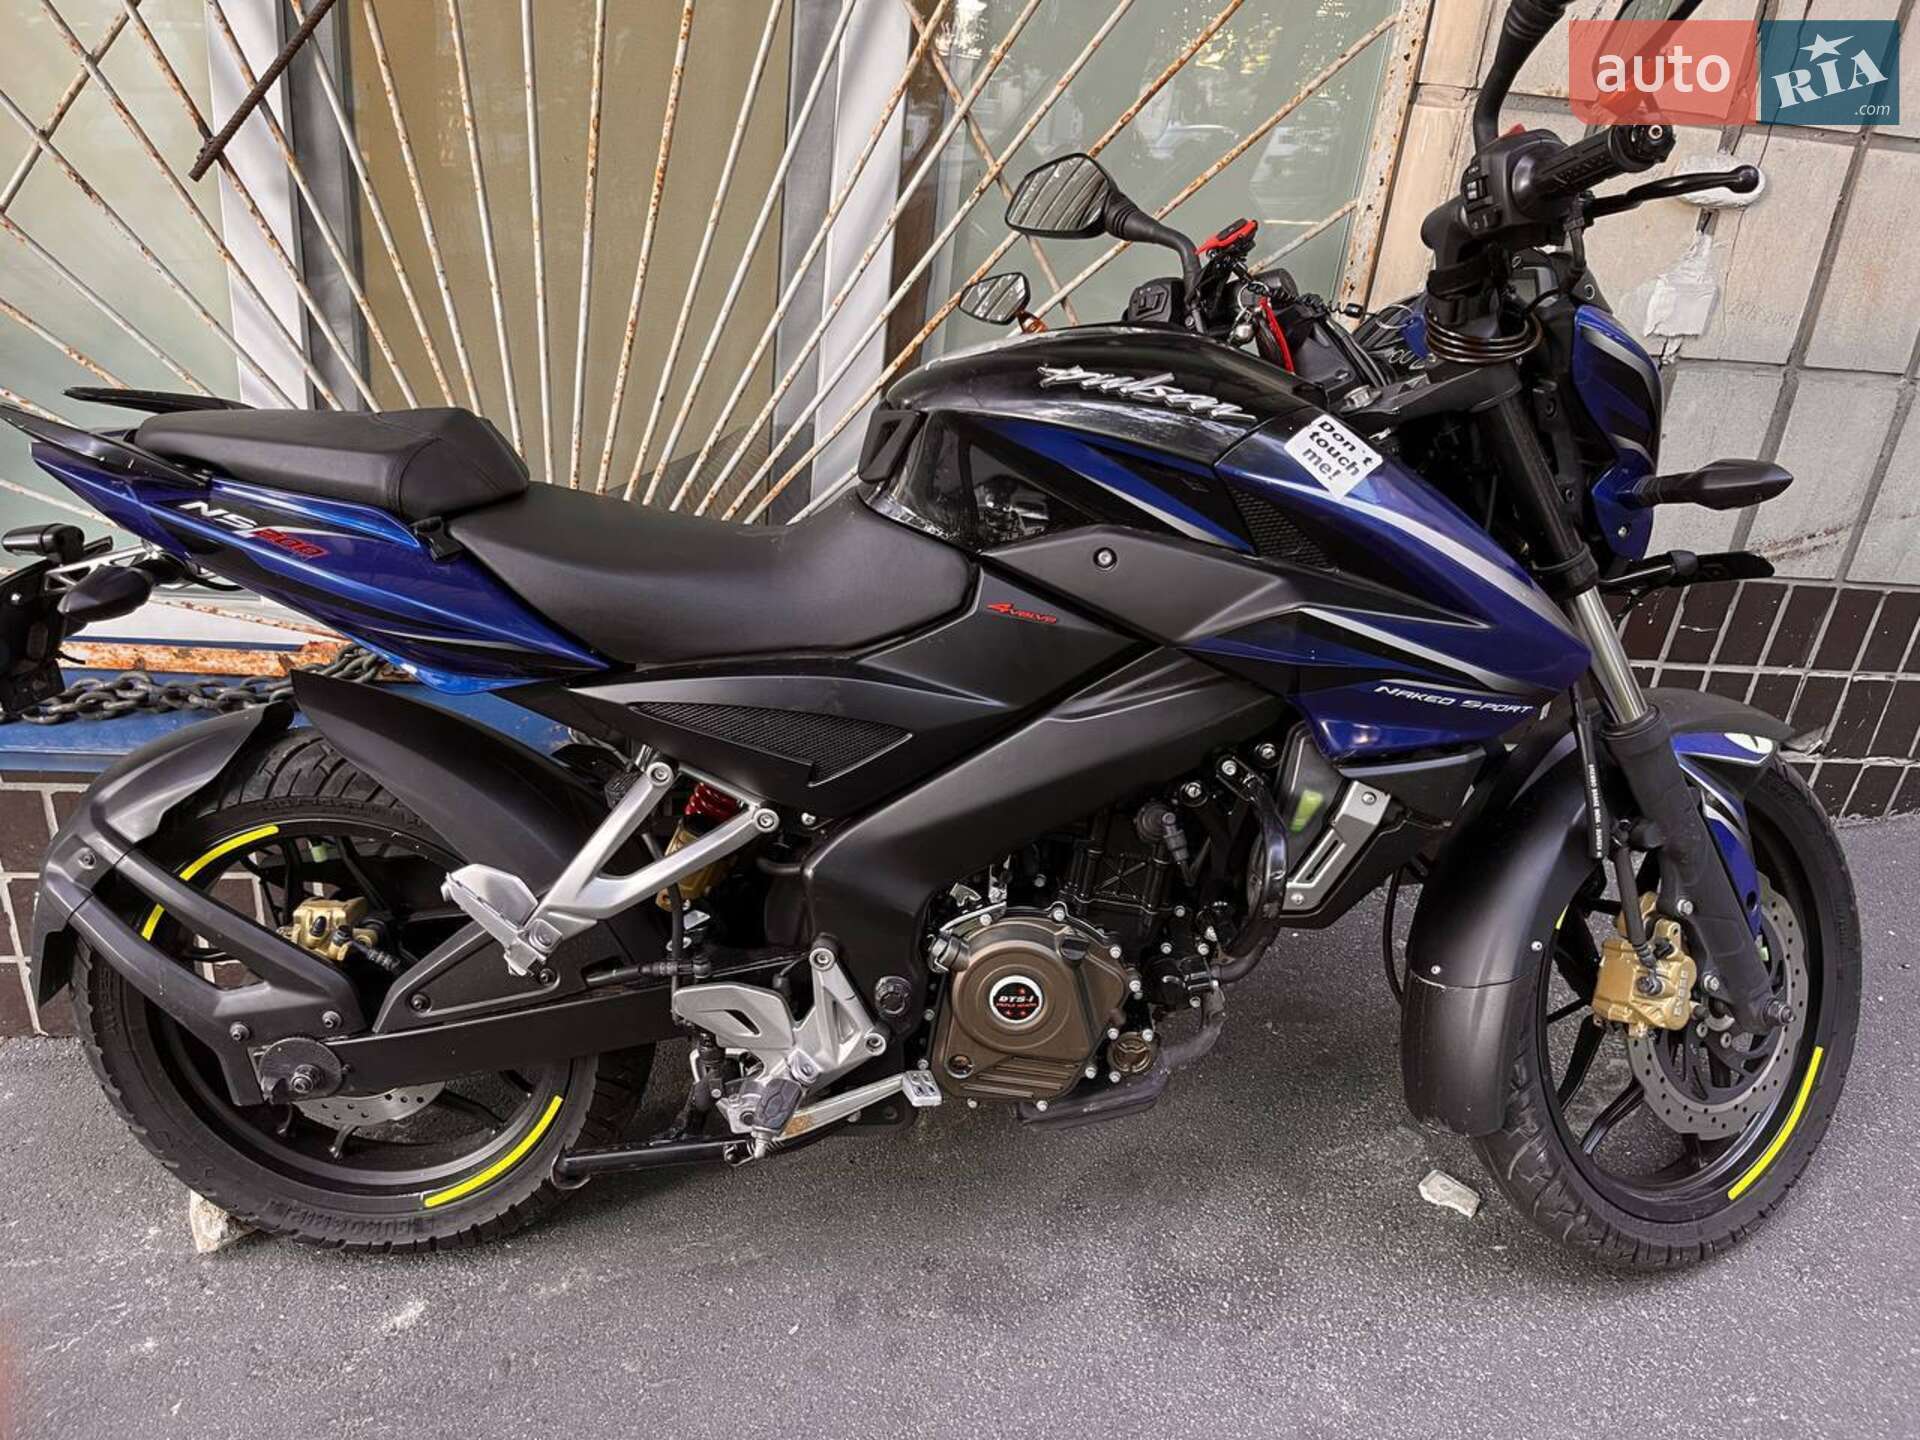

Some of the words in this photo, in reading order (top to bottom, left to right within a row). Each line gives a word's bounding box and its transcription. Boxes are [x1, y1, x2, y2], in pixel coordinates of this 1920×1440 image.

[1302, 447, 1342, 481] me!
[1308, 431, 1361, 477] touch
[1459, 699, 1534, 714] SPORT
